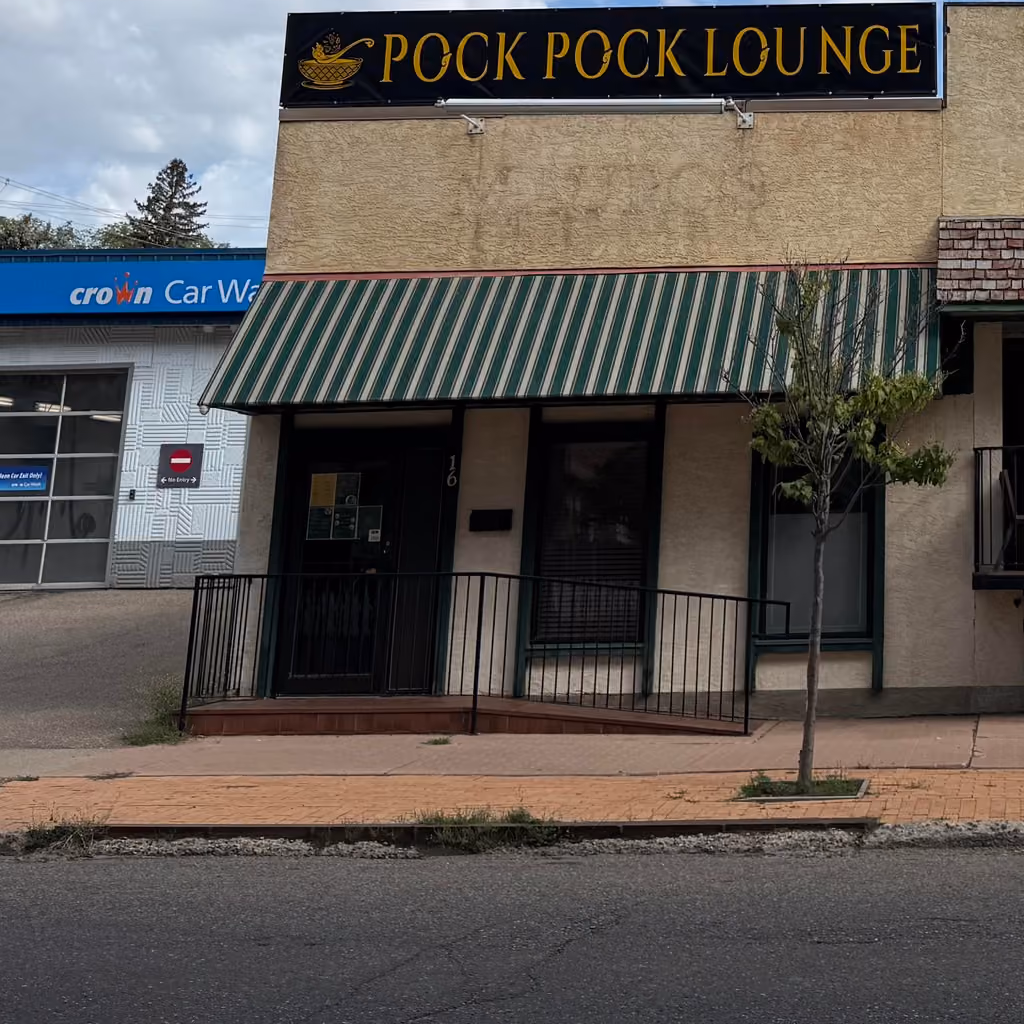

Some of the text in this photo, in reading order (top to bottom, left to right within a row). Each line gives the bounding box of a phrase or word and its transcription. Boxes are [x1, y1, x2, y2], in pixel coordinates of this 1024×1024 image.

[379, 24, 922, 83] POCK POCK LOUNGE
[70, 275, 153, 305] crown
[165, 280, 212, 304] Car
